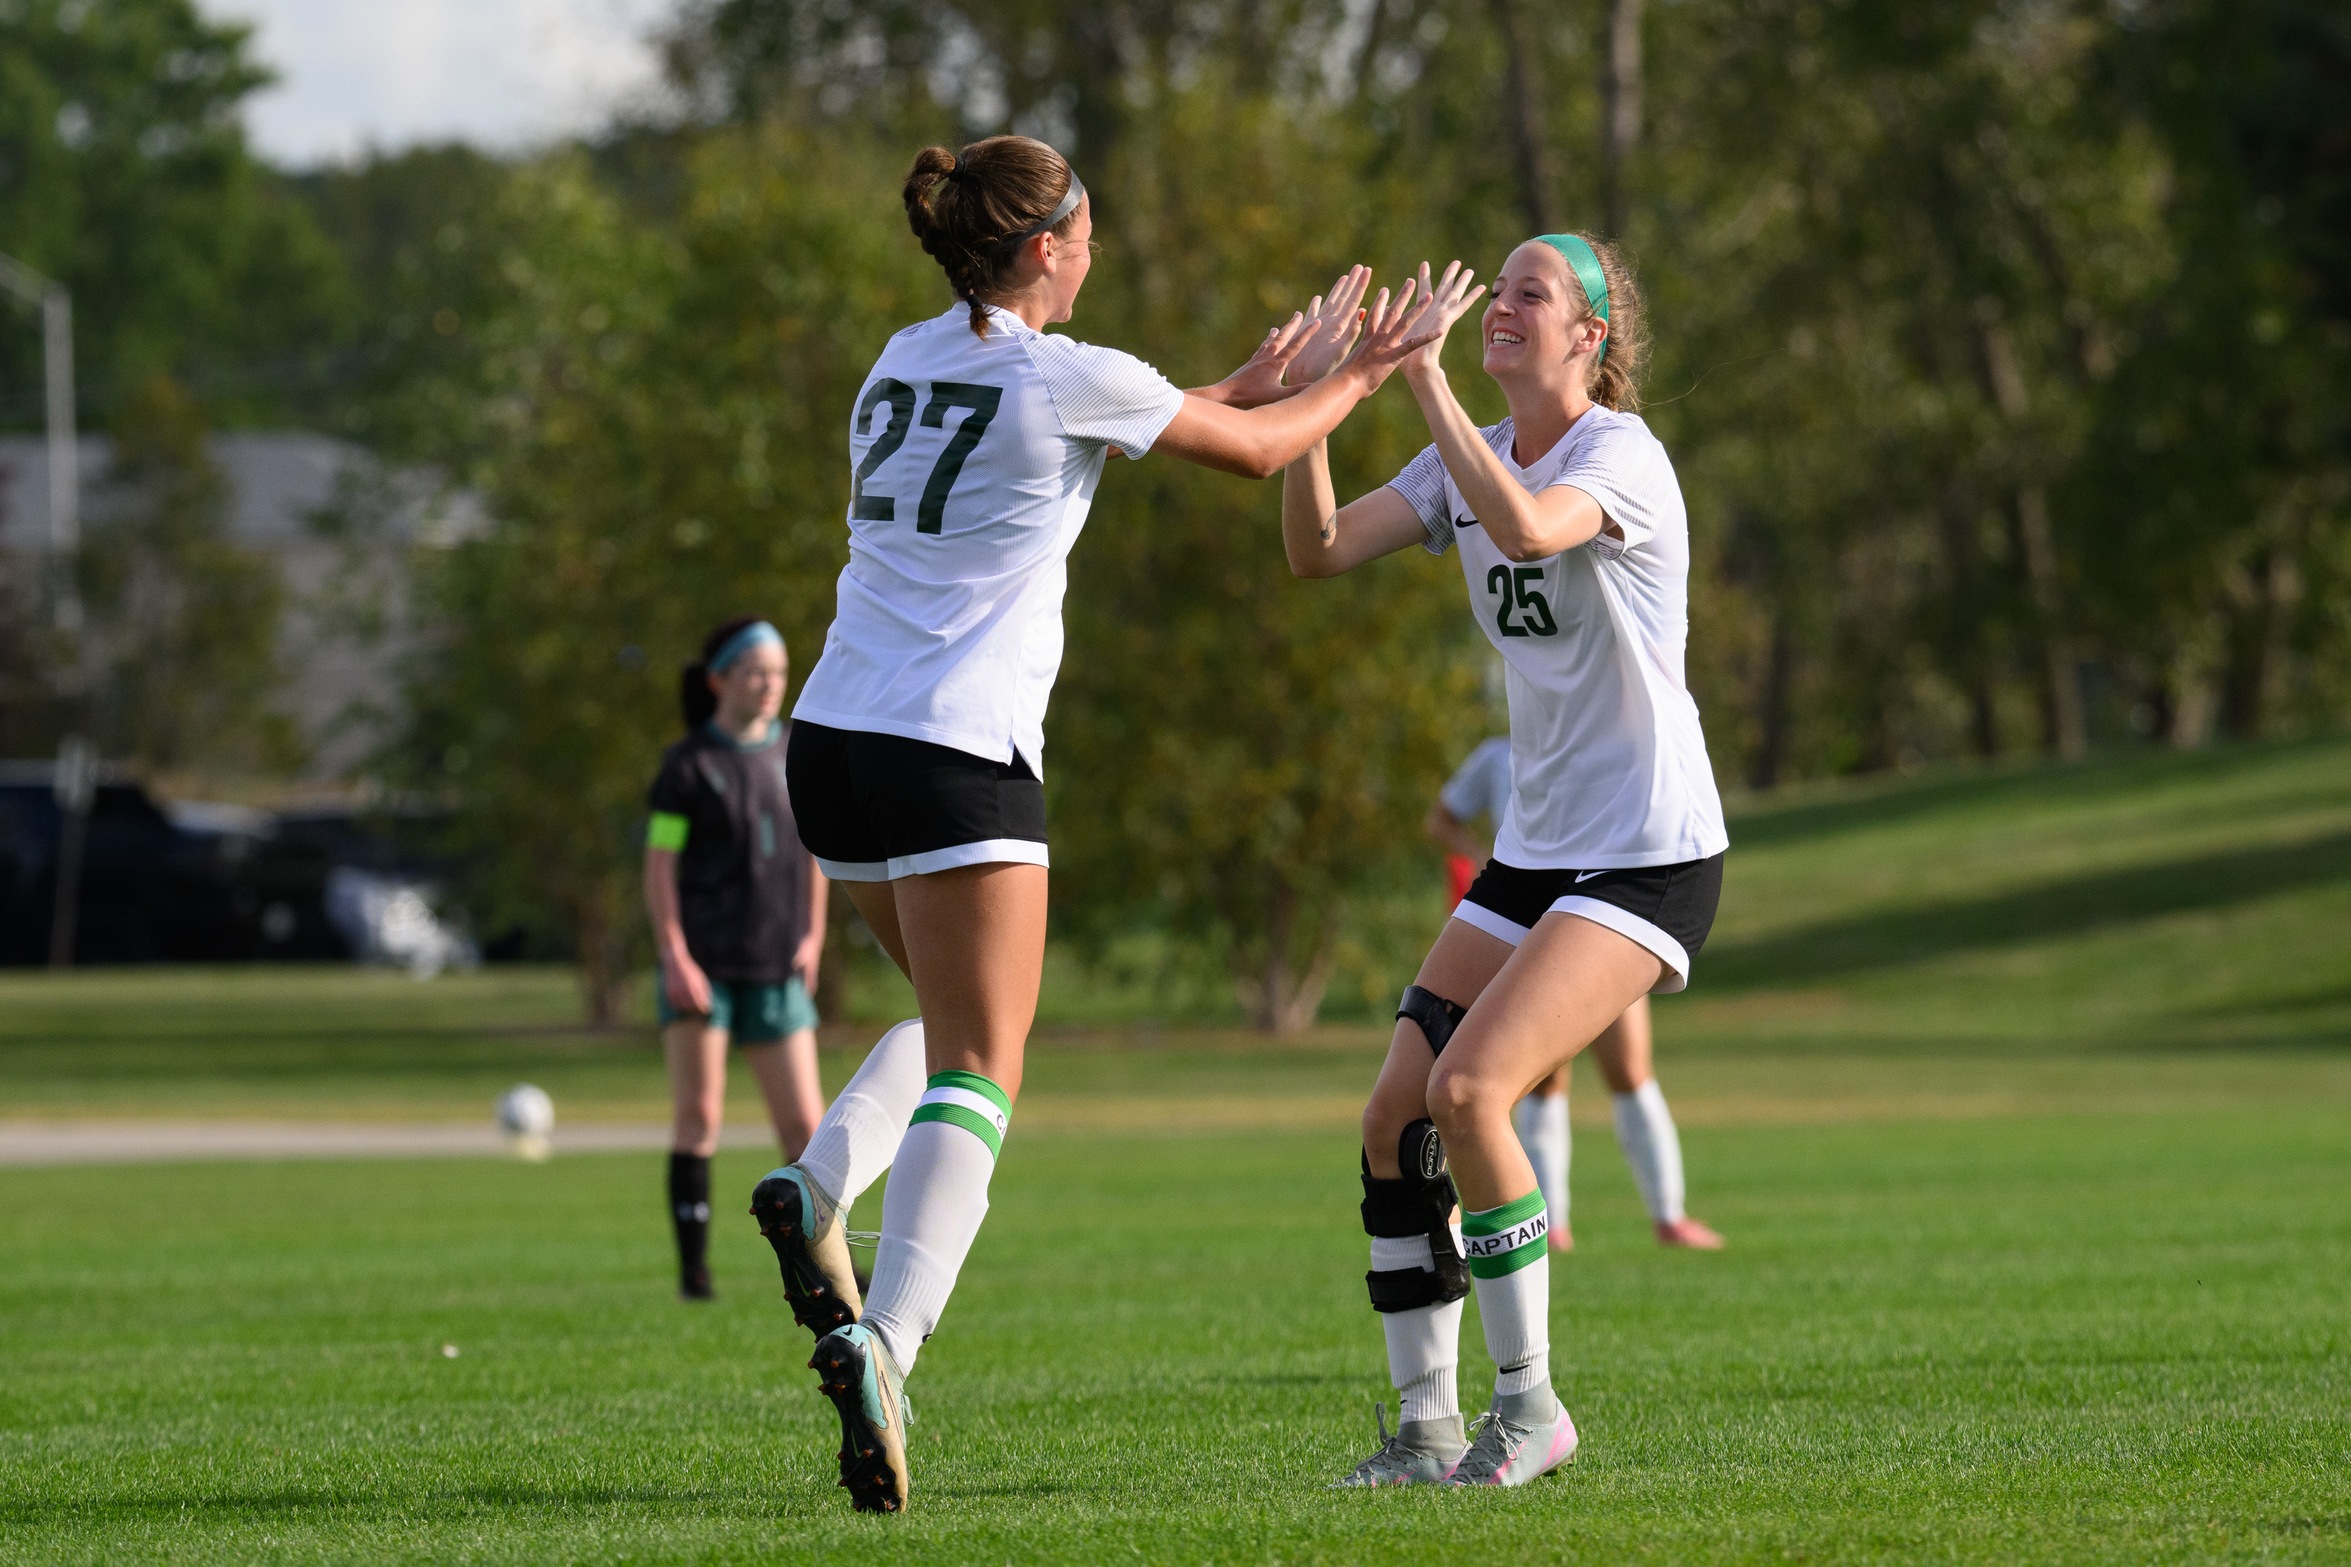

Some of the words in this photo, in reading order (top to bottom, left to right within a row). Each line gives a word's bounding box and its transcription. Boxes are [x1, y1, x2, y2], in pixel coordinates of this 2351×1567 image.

[852, 377, 1003, 535] 27
[1487, 564, 1558, 637] 25
[1462, 1215, 1546, 1255] CAPTAIN
